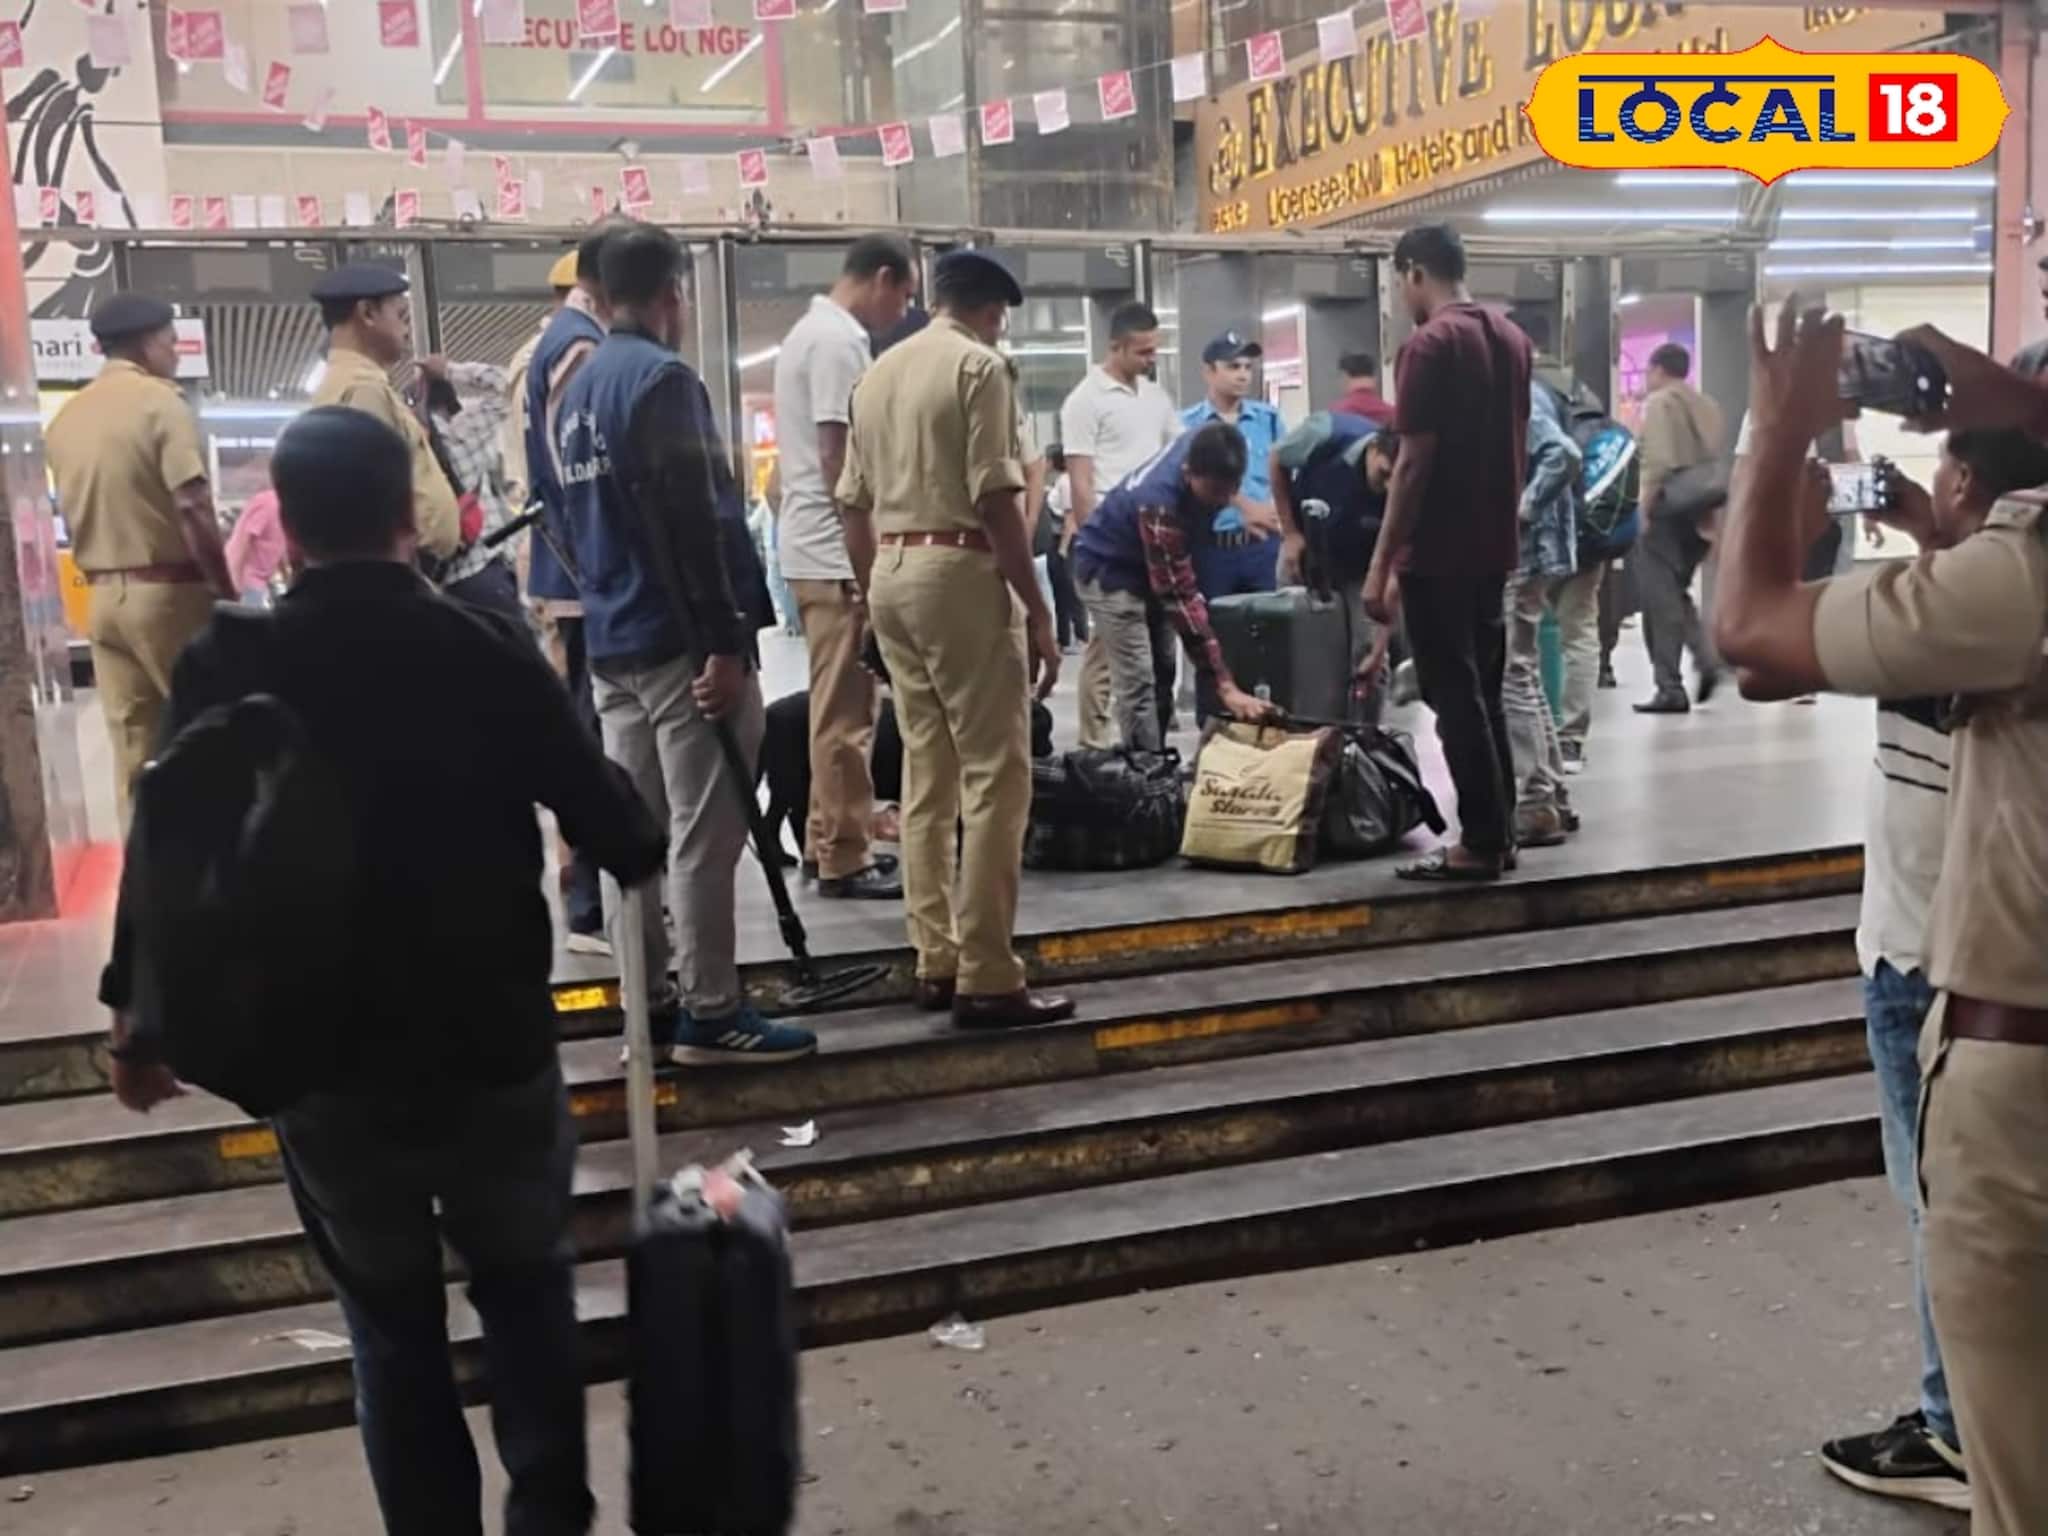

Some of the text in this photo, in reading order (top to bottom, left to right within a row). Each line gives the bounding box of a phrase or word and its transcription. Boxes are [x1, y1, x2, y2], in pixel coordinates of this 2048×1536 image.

[1248, 3, 1494, 178] EXECUTIVE
[1393, 127, 1458, 187] Hotels
[1462, 104, 1511, 163] and
